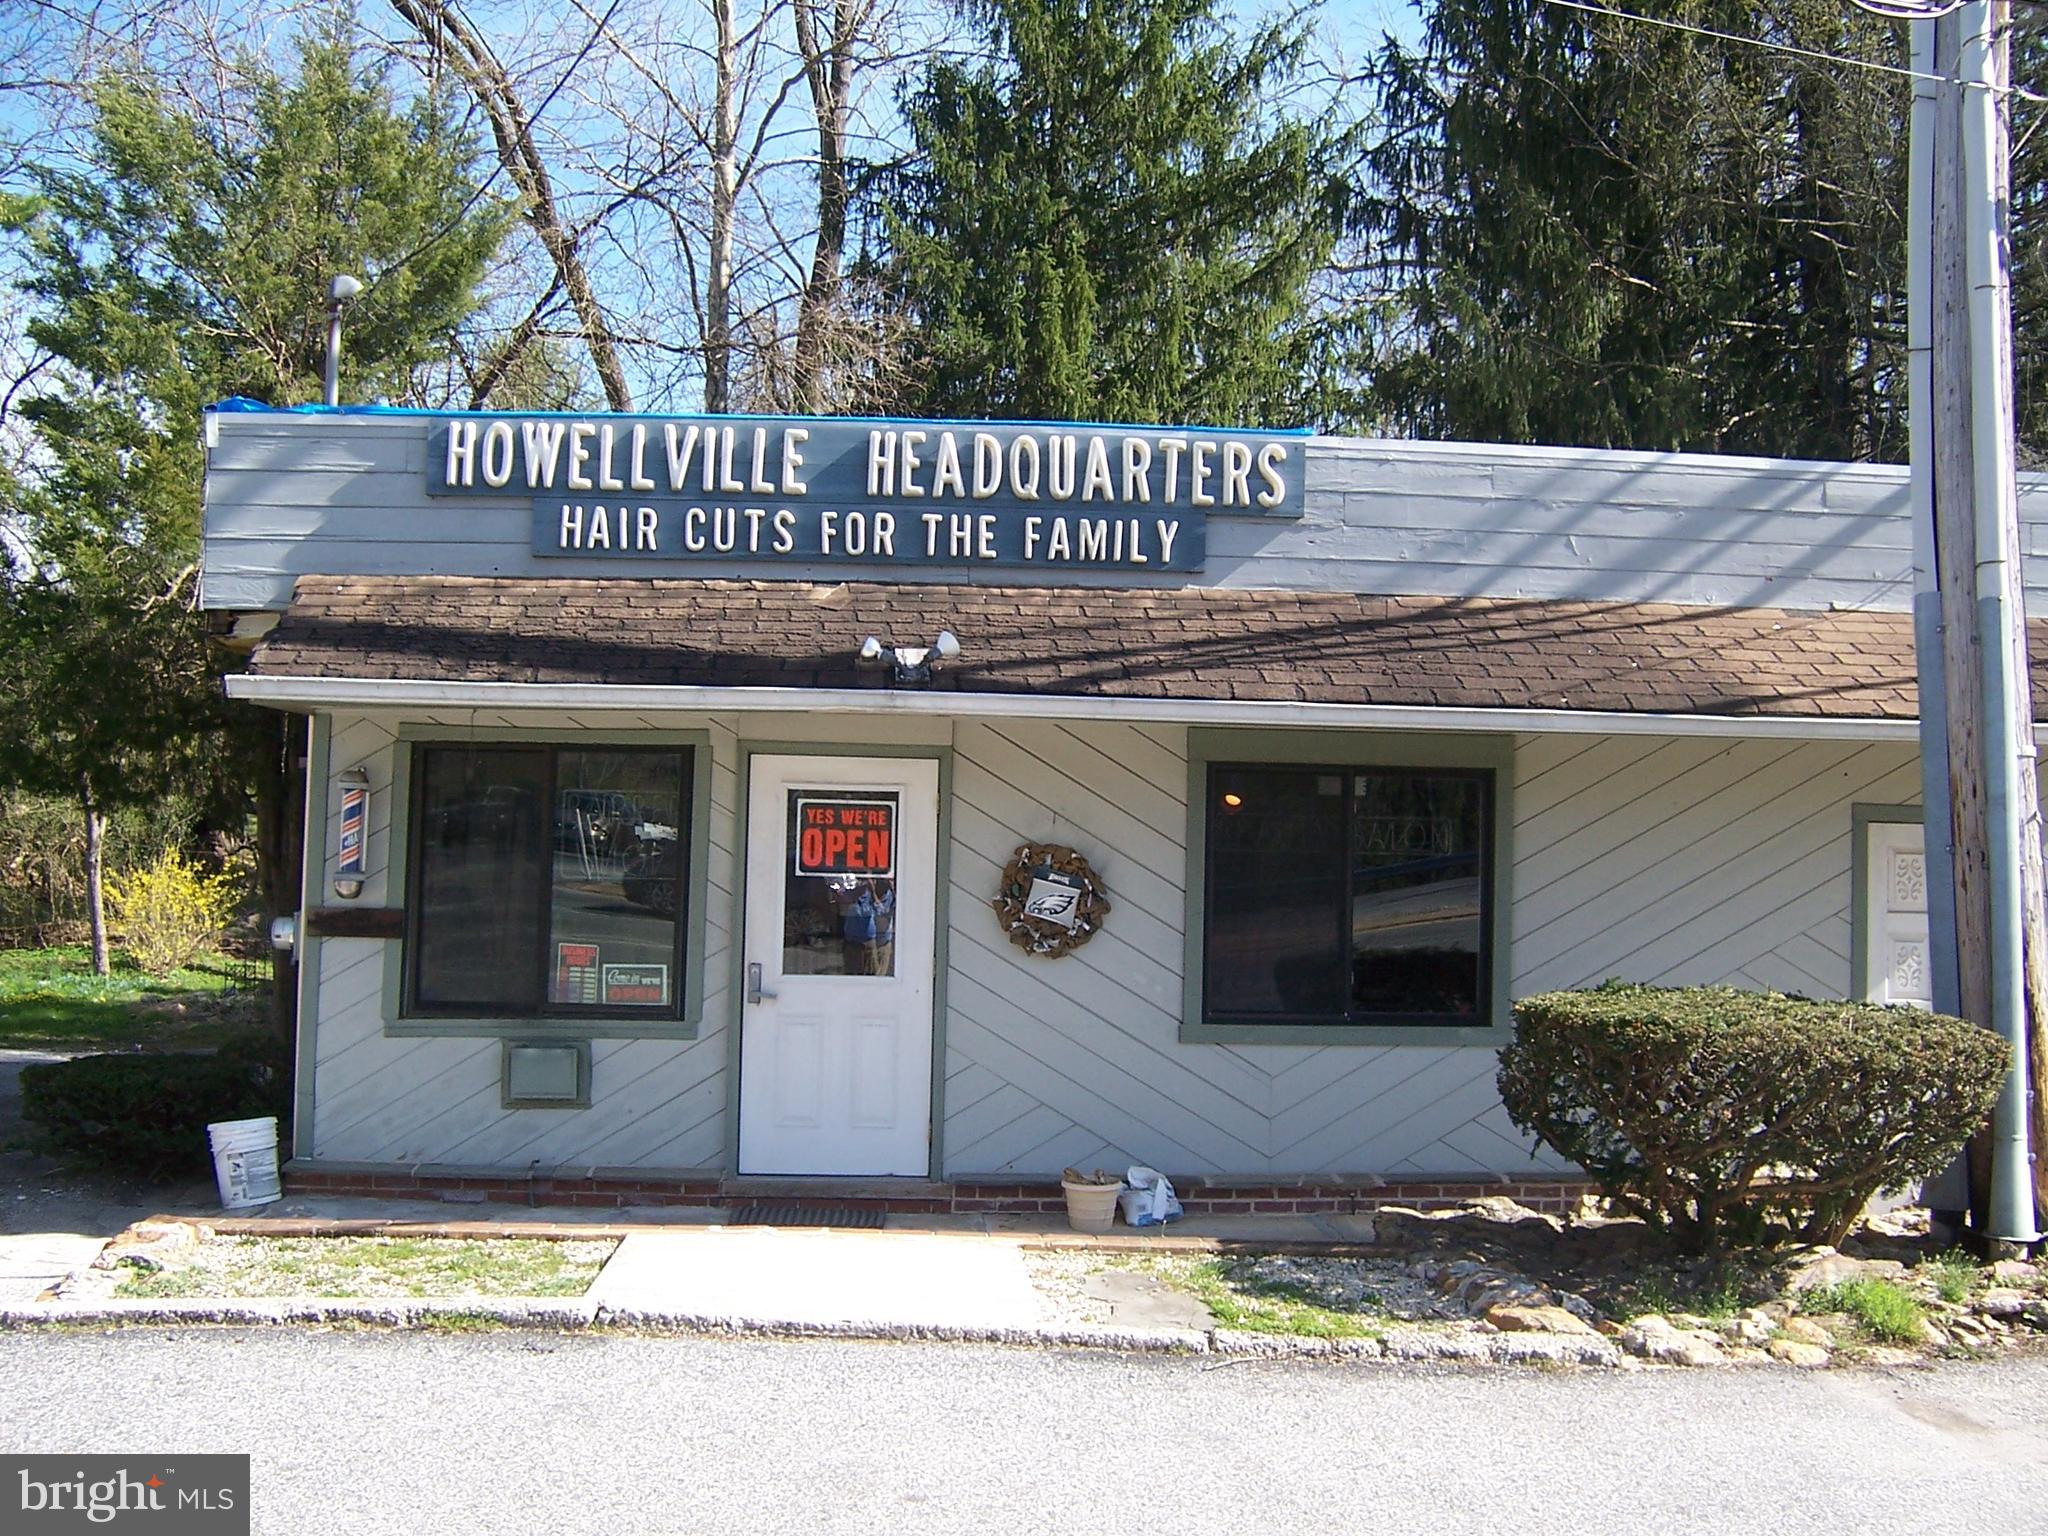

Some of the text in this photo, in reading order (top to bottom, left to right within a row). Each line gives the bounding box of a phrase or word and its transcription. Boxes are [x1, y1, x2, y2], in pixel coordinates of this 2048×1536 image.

[445, 421, 1288, 508] HOWELLVILLE HEADQUARTERS
[559, 504, 1180, 564] HAIR CUTS FOR THE FAMILY
[807, 808, 887, 826] YES WE'RE
[802, 827, 890, 868] OPEN
